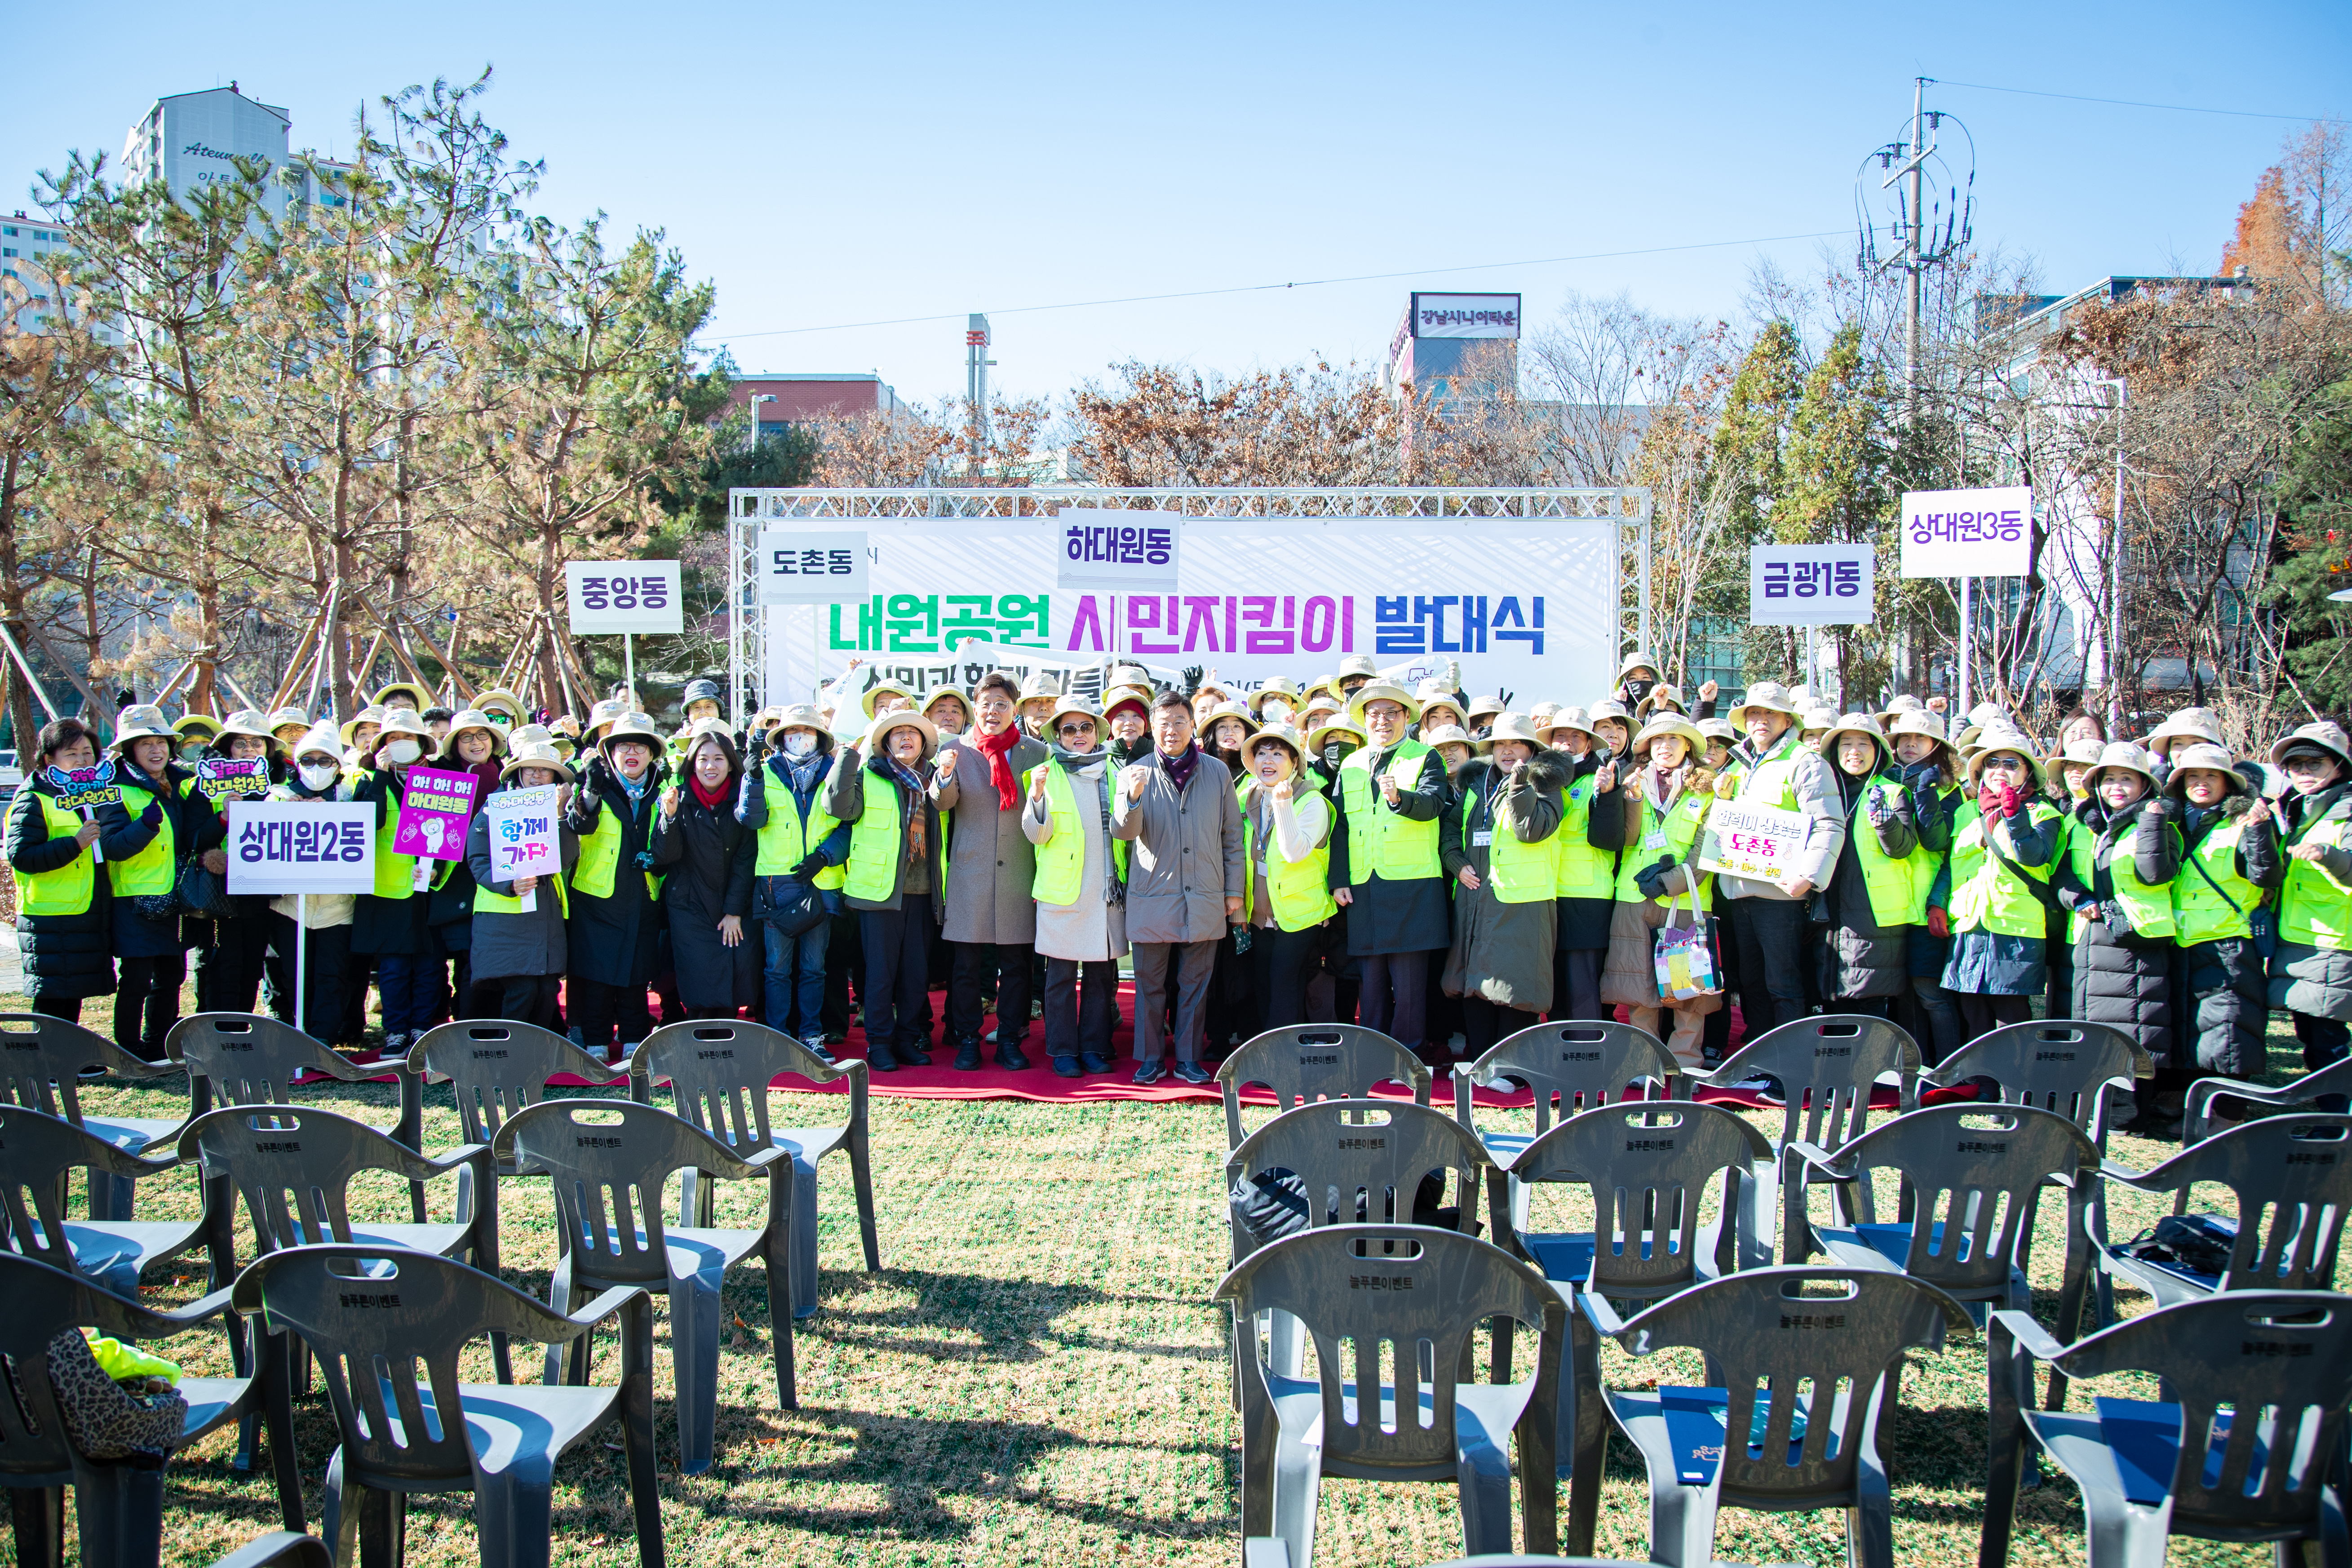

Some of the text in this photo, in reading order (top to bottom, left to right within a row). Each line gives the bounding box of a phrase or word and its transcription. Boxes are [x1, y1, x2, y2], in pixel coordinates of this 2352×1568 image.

[183, 142, 264, 164] Ateunll
[1421, 310, 1515, 325] 강남시니어타운
[1909, 510, 2023, 545] 상대원3동
[1067, 526, 1171, 565] 하대원동
[773, 549, 852, 575] 도촌동
[1763, 561, 1860, 598] 금광1동
[582, 577, 668, 610] 중앙동
[1067, 596, 1353, 654] 시민지킴이
[1376, 596, 1544, 655] 발대식
[210, 762, 256, 779] 달려라
[203, 775, 267, 796] 상대원2동
[412, 775, 473, 795] 하! 하! 하!
[58, 788, 120, 809] 상대원2동!
[408, 791, 469, 815] 하대원동
[499, 791, 545, 809] 하대원동
[1717, 809, 1758, 831] 활력이
[500, 817, 548, 842] 함께
[239, 821, 365, 863] 상대원2동
[1730, 833, 1777, 856] 도촌동
[502, 843, 548, 864] 가자
[4, 1042, 40, 1050] 늘푸른이벤트
[221, 1043, 253, 1051] 늘푸른이벤트
[473, 1050, 508, 1059] 늘푸른이벤트
[698, 1050, 734, 1059] 늘푸른이벤트
[1815, 1048, 1851, 1057] 늘푸른이벤트
[1300, 1056, 1338, 1065] 늘푸른이벤트
[1563, 1052, 1600, 1061] 늘푸른이벤트
[2036, 1052, 2075, 1061] 늘푸른이벤트
[256, 1142, 301, 1152] 늘푸른이벤트
[577, 1136, 622, 1148] 늘푸른이벤트
[1338, 1138, 1385, 1149] 늘푸른이벤트
[1626, 1140, 1674, 1151] 늘푸른이벤트
[1958, 1141, 2006, 1153] 늘푸른이벤트
[1350, 1275, 1413, 1290] 늘푸른이벤트
[340, 1293, 401, 1307] 늘푸른이벤트
